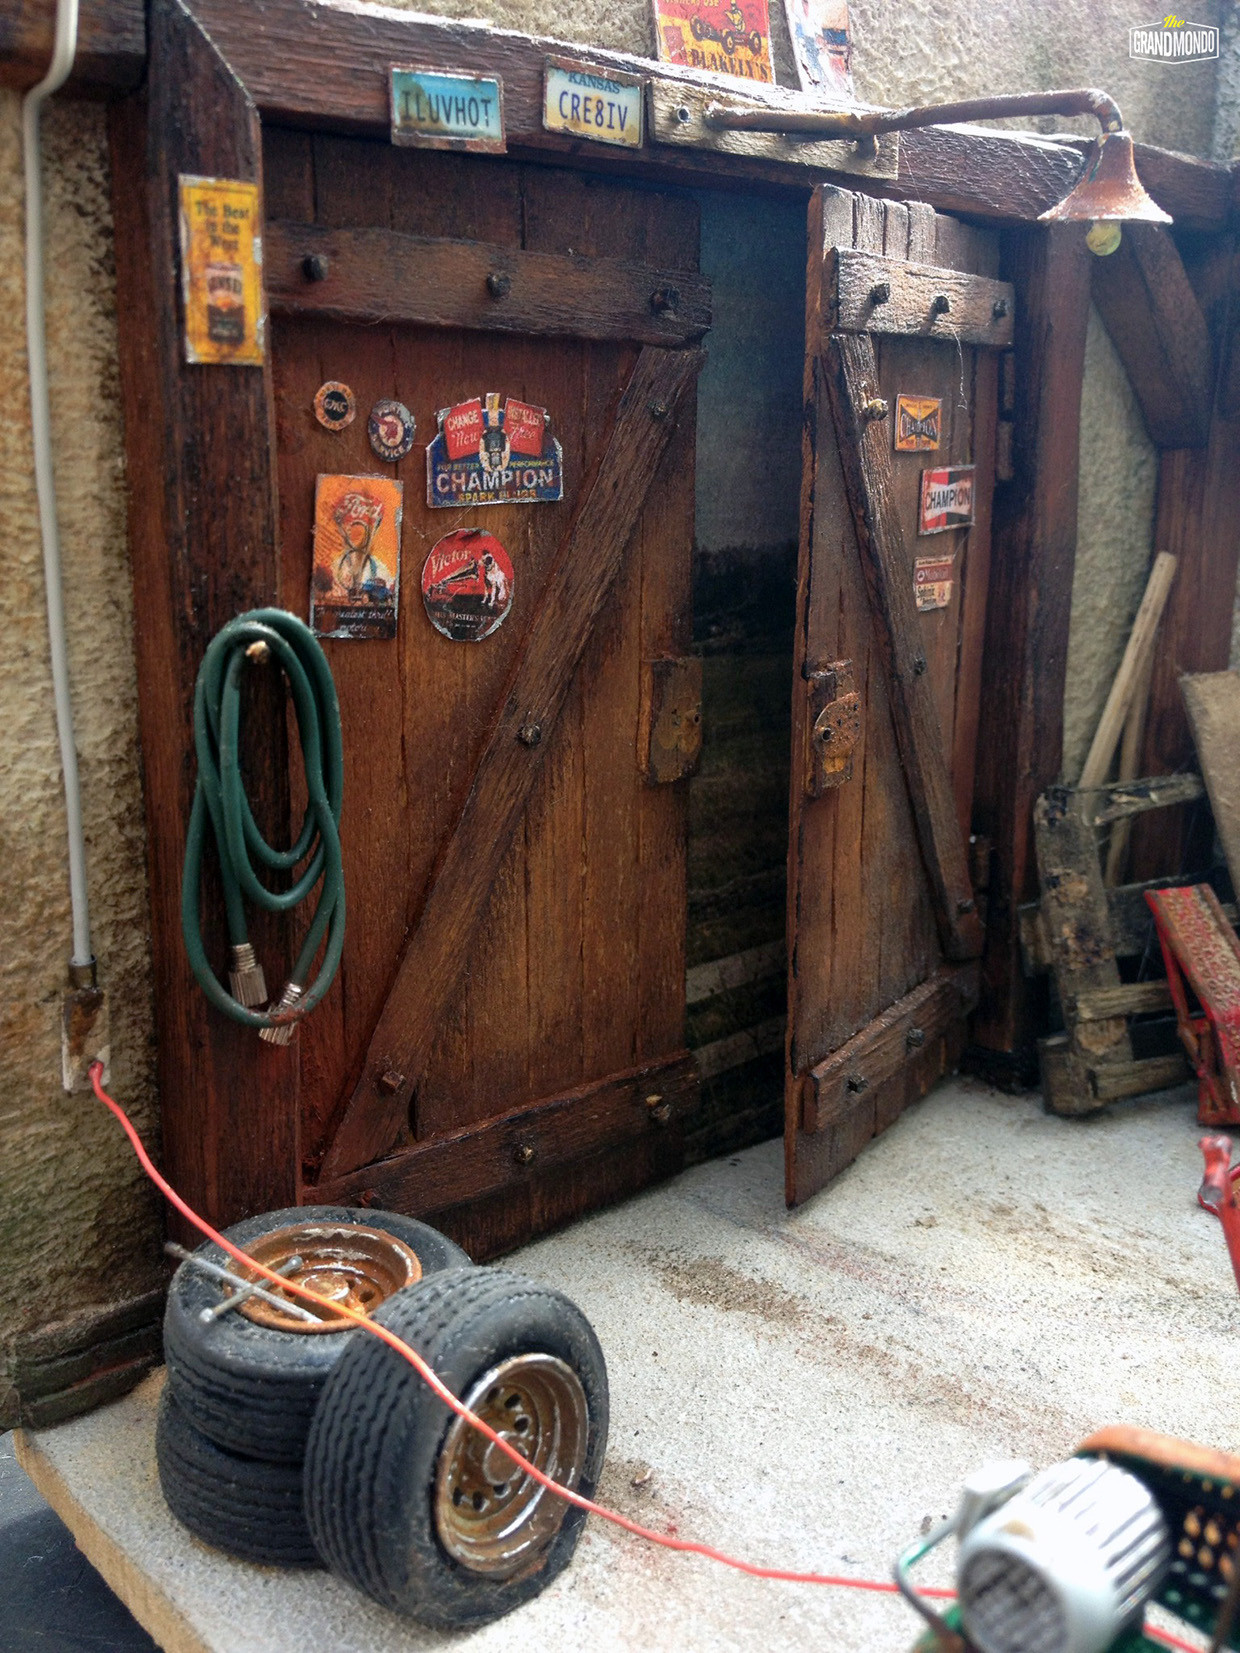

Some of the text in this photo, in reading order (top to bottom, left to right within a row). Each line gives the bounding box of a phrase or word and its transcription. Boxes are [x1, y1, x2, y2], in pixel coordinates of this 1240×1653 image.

[568, 72, 621, 95] KANSAS
[402, 91, 491, 127] ILUVHOT
[559, 91, 629, 132] CRE8IV
[447, 409, 479, 431] CHANGE
[901, 412, 938, 438] CHAMPION
[436, 468, 553, 493] CHAMPION
[925, 488, 971, 511] CHAMPION
[430, 550, 471, 579] Victor
